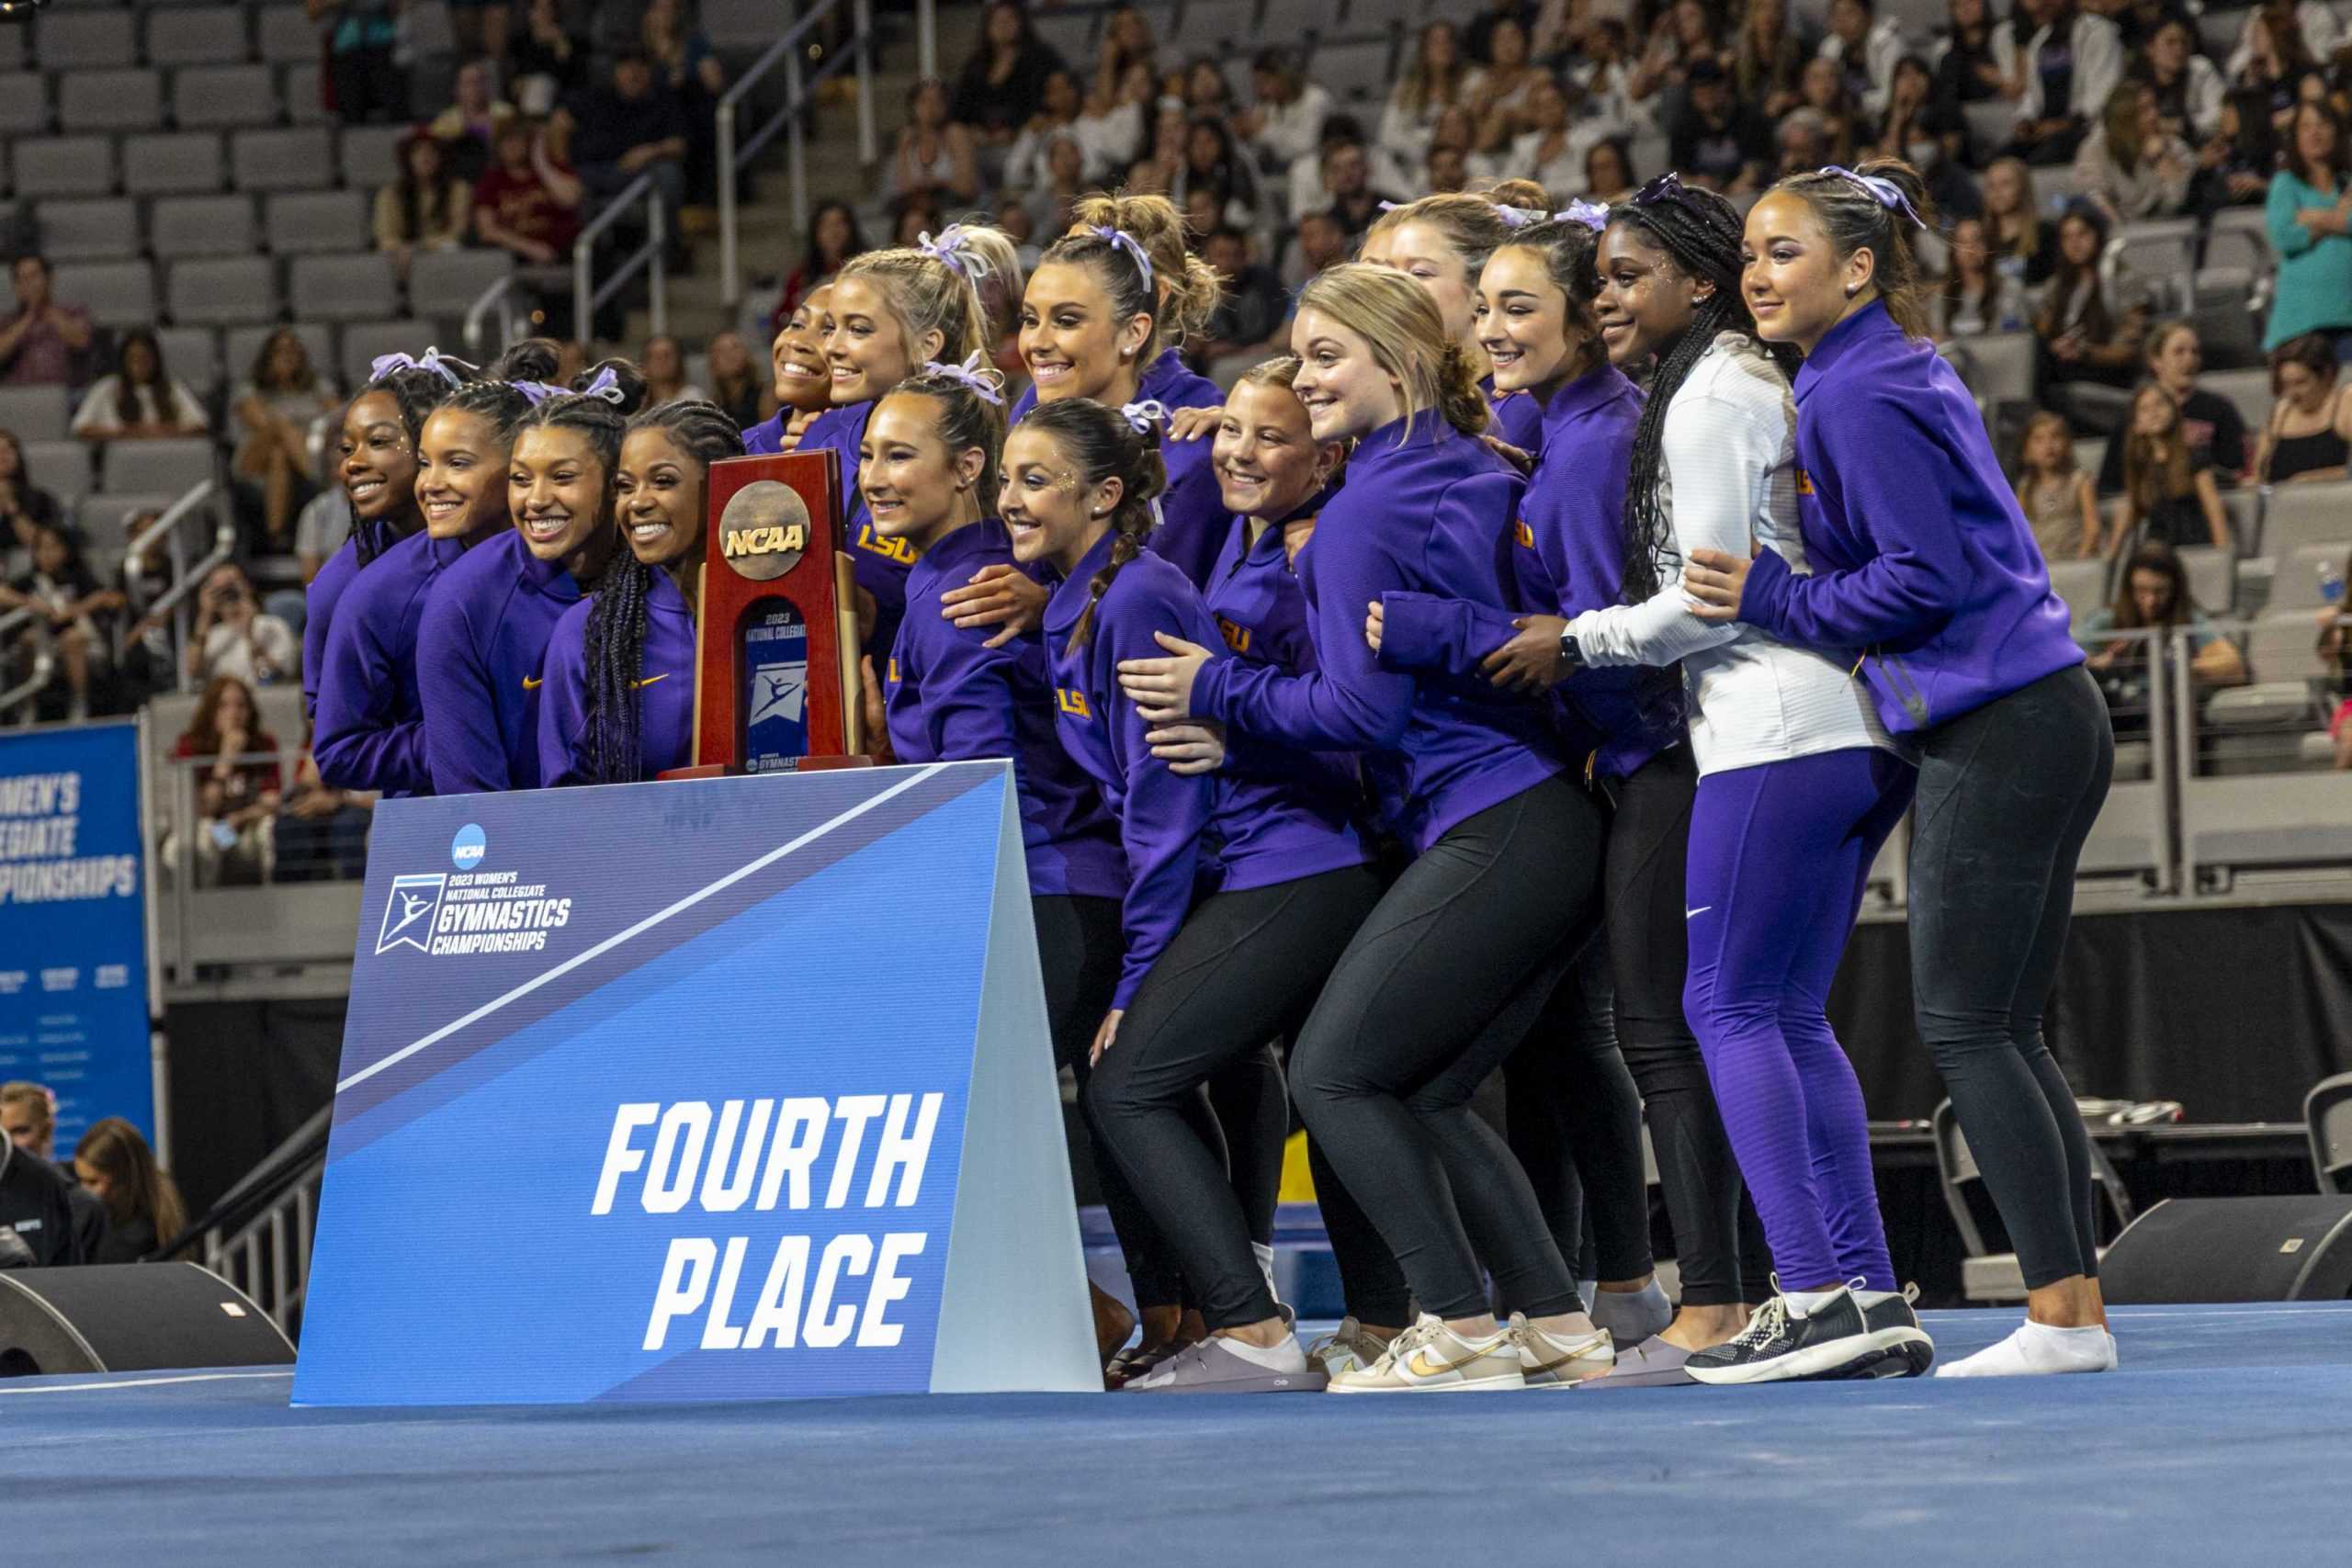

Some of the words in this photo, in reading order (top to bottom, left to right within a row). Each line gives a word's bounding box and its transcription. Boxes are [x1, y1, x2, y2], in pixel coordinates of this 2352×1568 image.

[726, 525, 805, 558] NCAA
[857, 525, 916, 565] LSU
[765, 613, 791, 626] 2023
[455, 845, 485, 860] NCAA
[446, 887, 491, 902] NATIONAL
[491, 885, 546, 899] COLLEGIATE
[448, 874, 474, 886] 2023
[474, 872, 518, 886] WOMEN'S
[437, 897, 571, 933] GYMNASTICS
[431, 931, 548, 956] CHAMPIONSHIPS
[591, 1092, 944, 1215] FOURTH
[642, 1233, 928, 1350] PLACE
